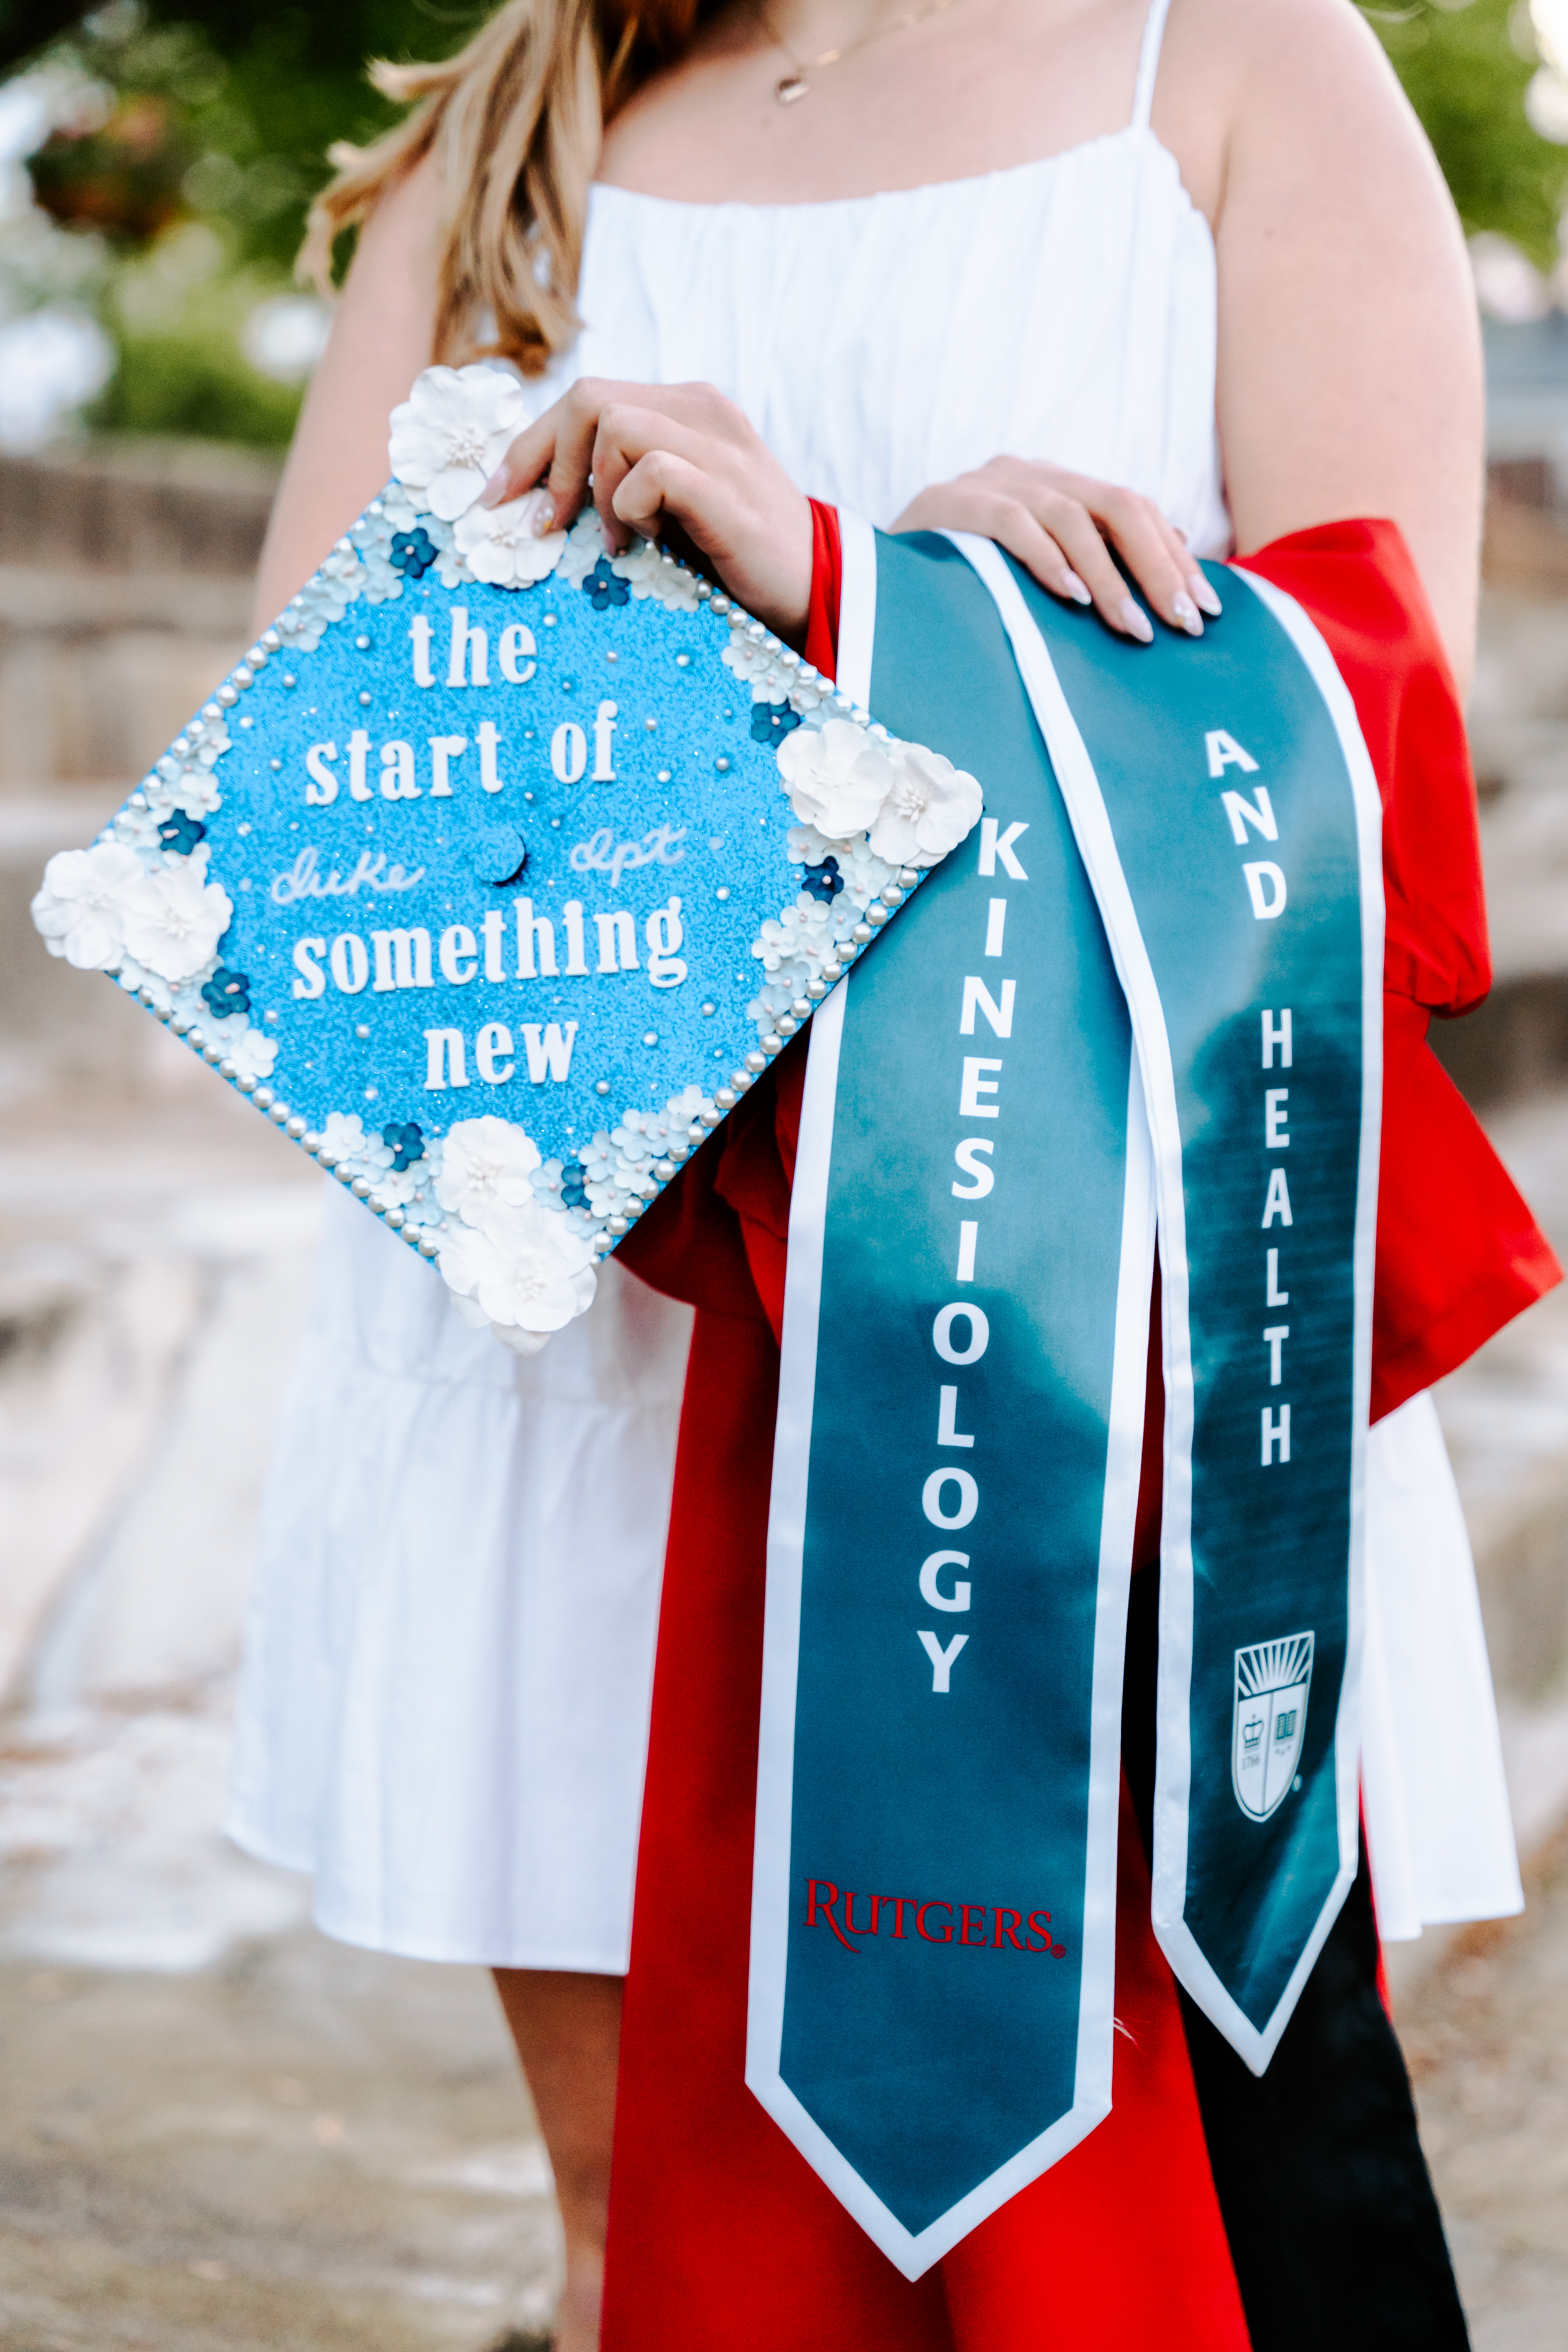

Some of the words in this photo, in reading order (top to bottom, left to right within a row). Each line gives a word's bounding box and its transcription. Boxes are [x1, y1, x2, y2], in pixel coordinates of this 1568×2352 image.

[410, 607, 537, 688] the
[305, 721, 503, 806] start
[550, 700, 618, 785] of
[272, 846, 425, 905] duke
[570, 822, 688, 888] dpt
[292, 896, 688, 1000] something
[423, 1021, 579, 1091] new
[1204, 728, 1287, 920] AND
[1260, 1008, 1293, 1466] HEALTH
[916, 817, 1030, 1693] KINESIOLOGY
